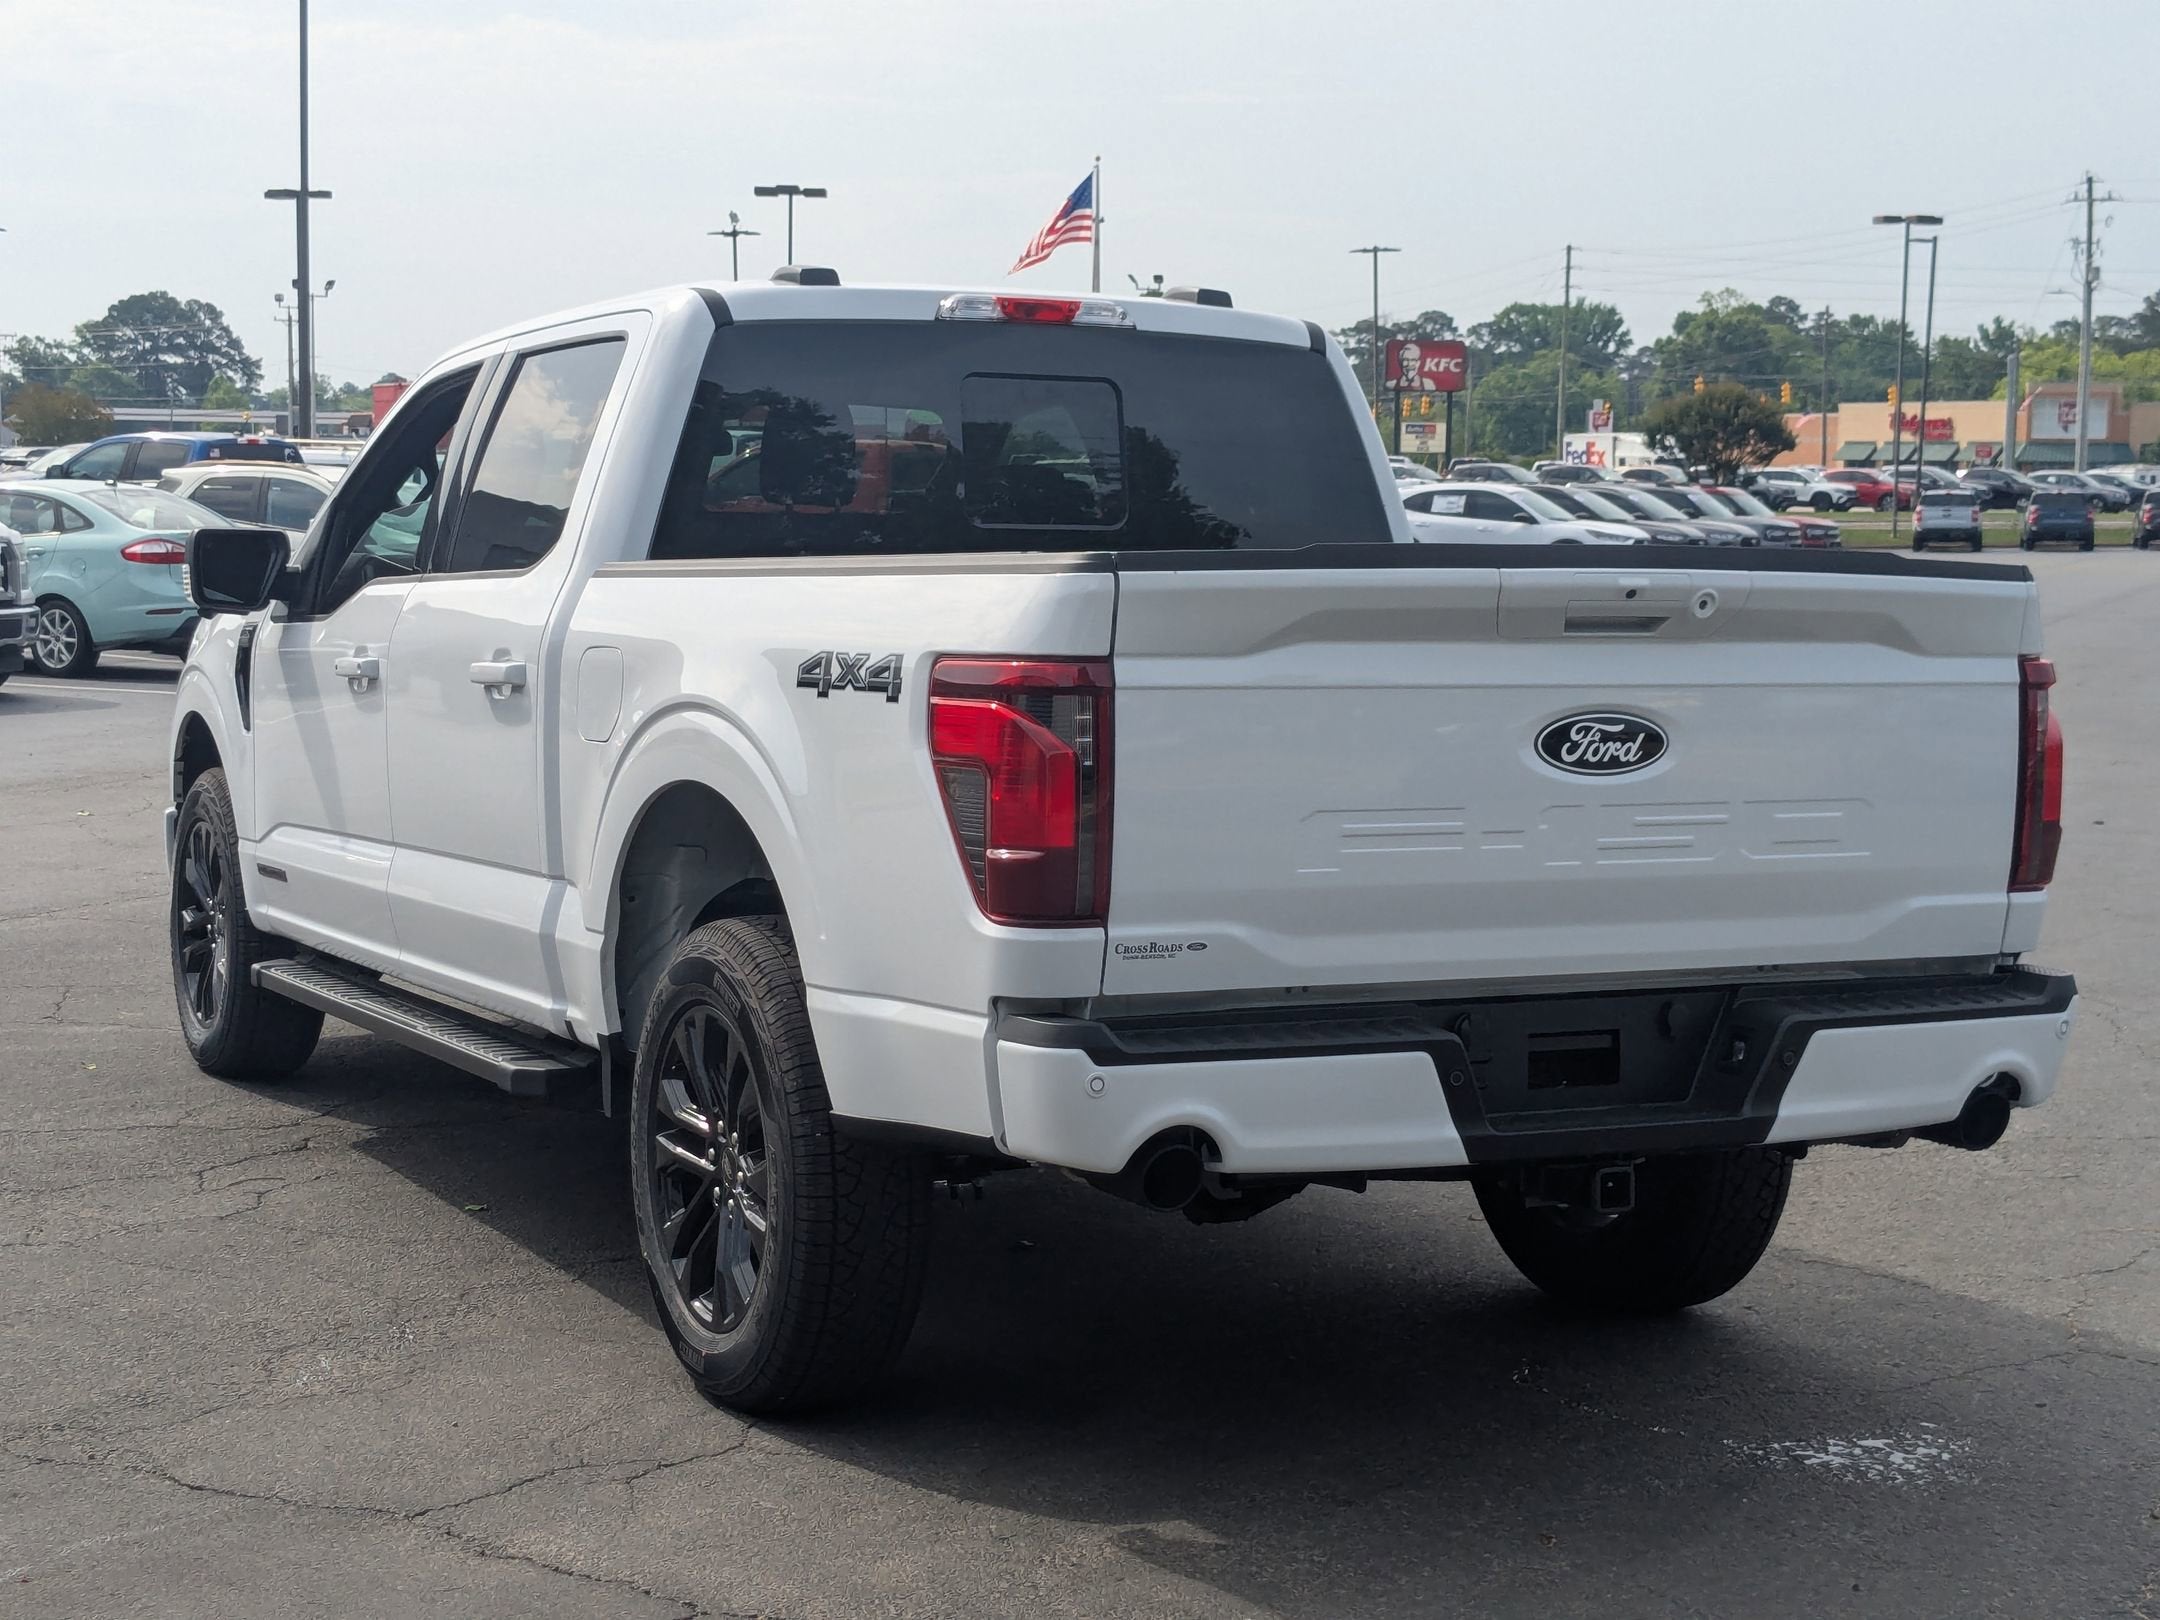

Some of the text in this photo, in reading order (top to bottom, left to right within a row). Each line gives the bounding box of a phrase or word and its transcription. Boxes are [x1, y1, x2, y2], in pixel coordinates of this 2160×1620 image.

[1423, 357, 1463, 373] KFC
[1565, 441, 1606, 468] FedEx
[1560, 722, 1646, 762] Ford
